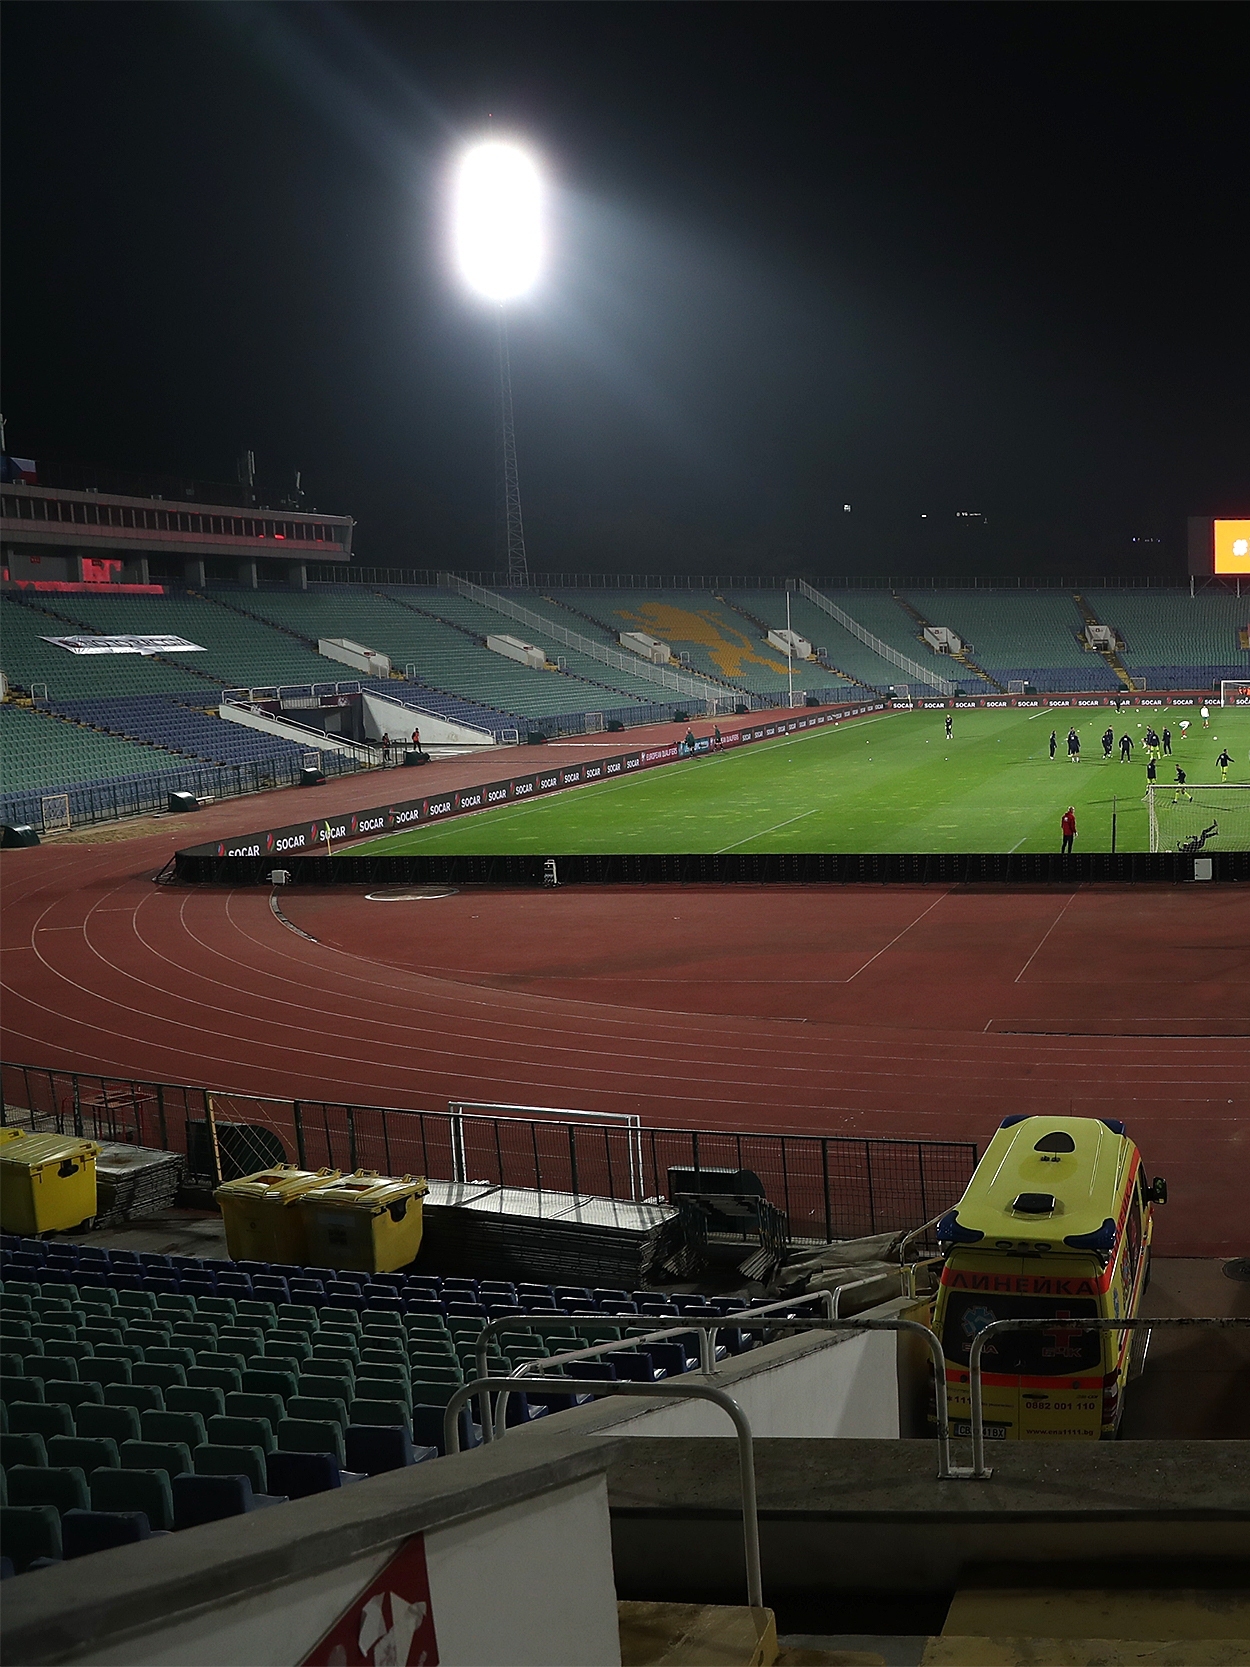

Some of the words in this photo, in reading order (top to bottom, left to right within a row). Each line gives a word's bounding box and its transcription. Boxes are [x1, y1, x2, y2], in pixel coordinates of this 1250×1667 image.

[228, 845, 260, 857] SOCAR
[276, 834, 305, 851] SOCAR
[319, 826, 346, 842] SOCAR
[359, 817, 384, 832] SOCAR
[396, 809, 419, 824] SOCAR
[429, 802, 451, 816] SOCAR
[461, 795, 481, 808] SOCAR
[488, 789, 507, 802] SOCAR
[515, 783, 533, 796] SOCAR
[541, 777, 557, 789] SOCAR
[564, 772, 580, 784] SOCAR
[587, 767, 601, 778] SOCAR
[607, 763, 621, 774] SOCAR
[627, 758, 640, 769] SOCAR
[951, 1273, 1094, 1295] ЛИНЕЙКА
[1025, 1401, 1051, 1410] 0882
[1054, 1402, 1072, 1410] 001
[1076, 1402, 1095, 1410] 110
